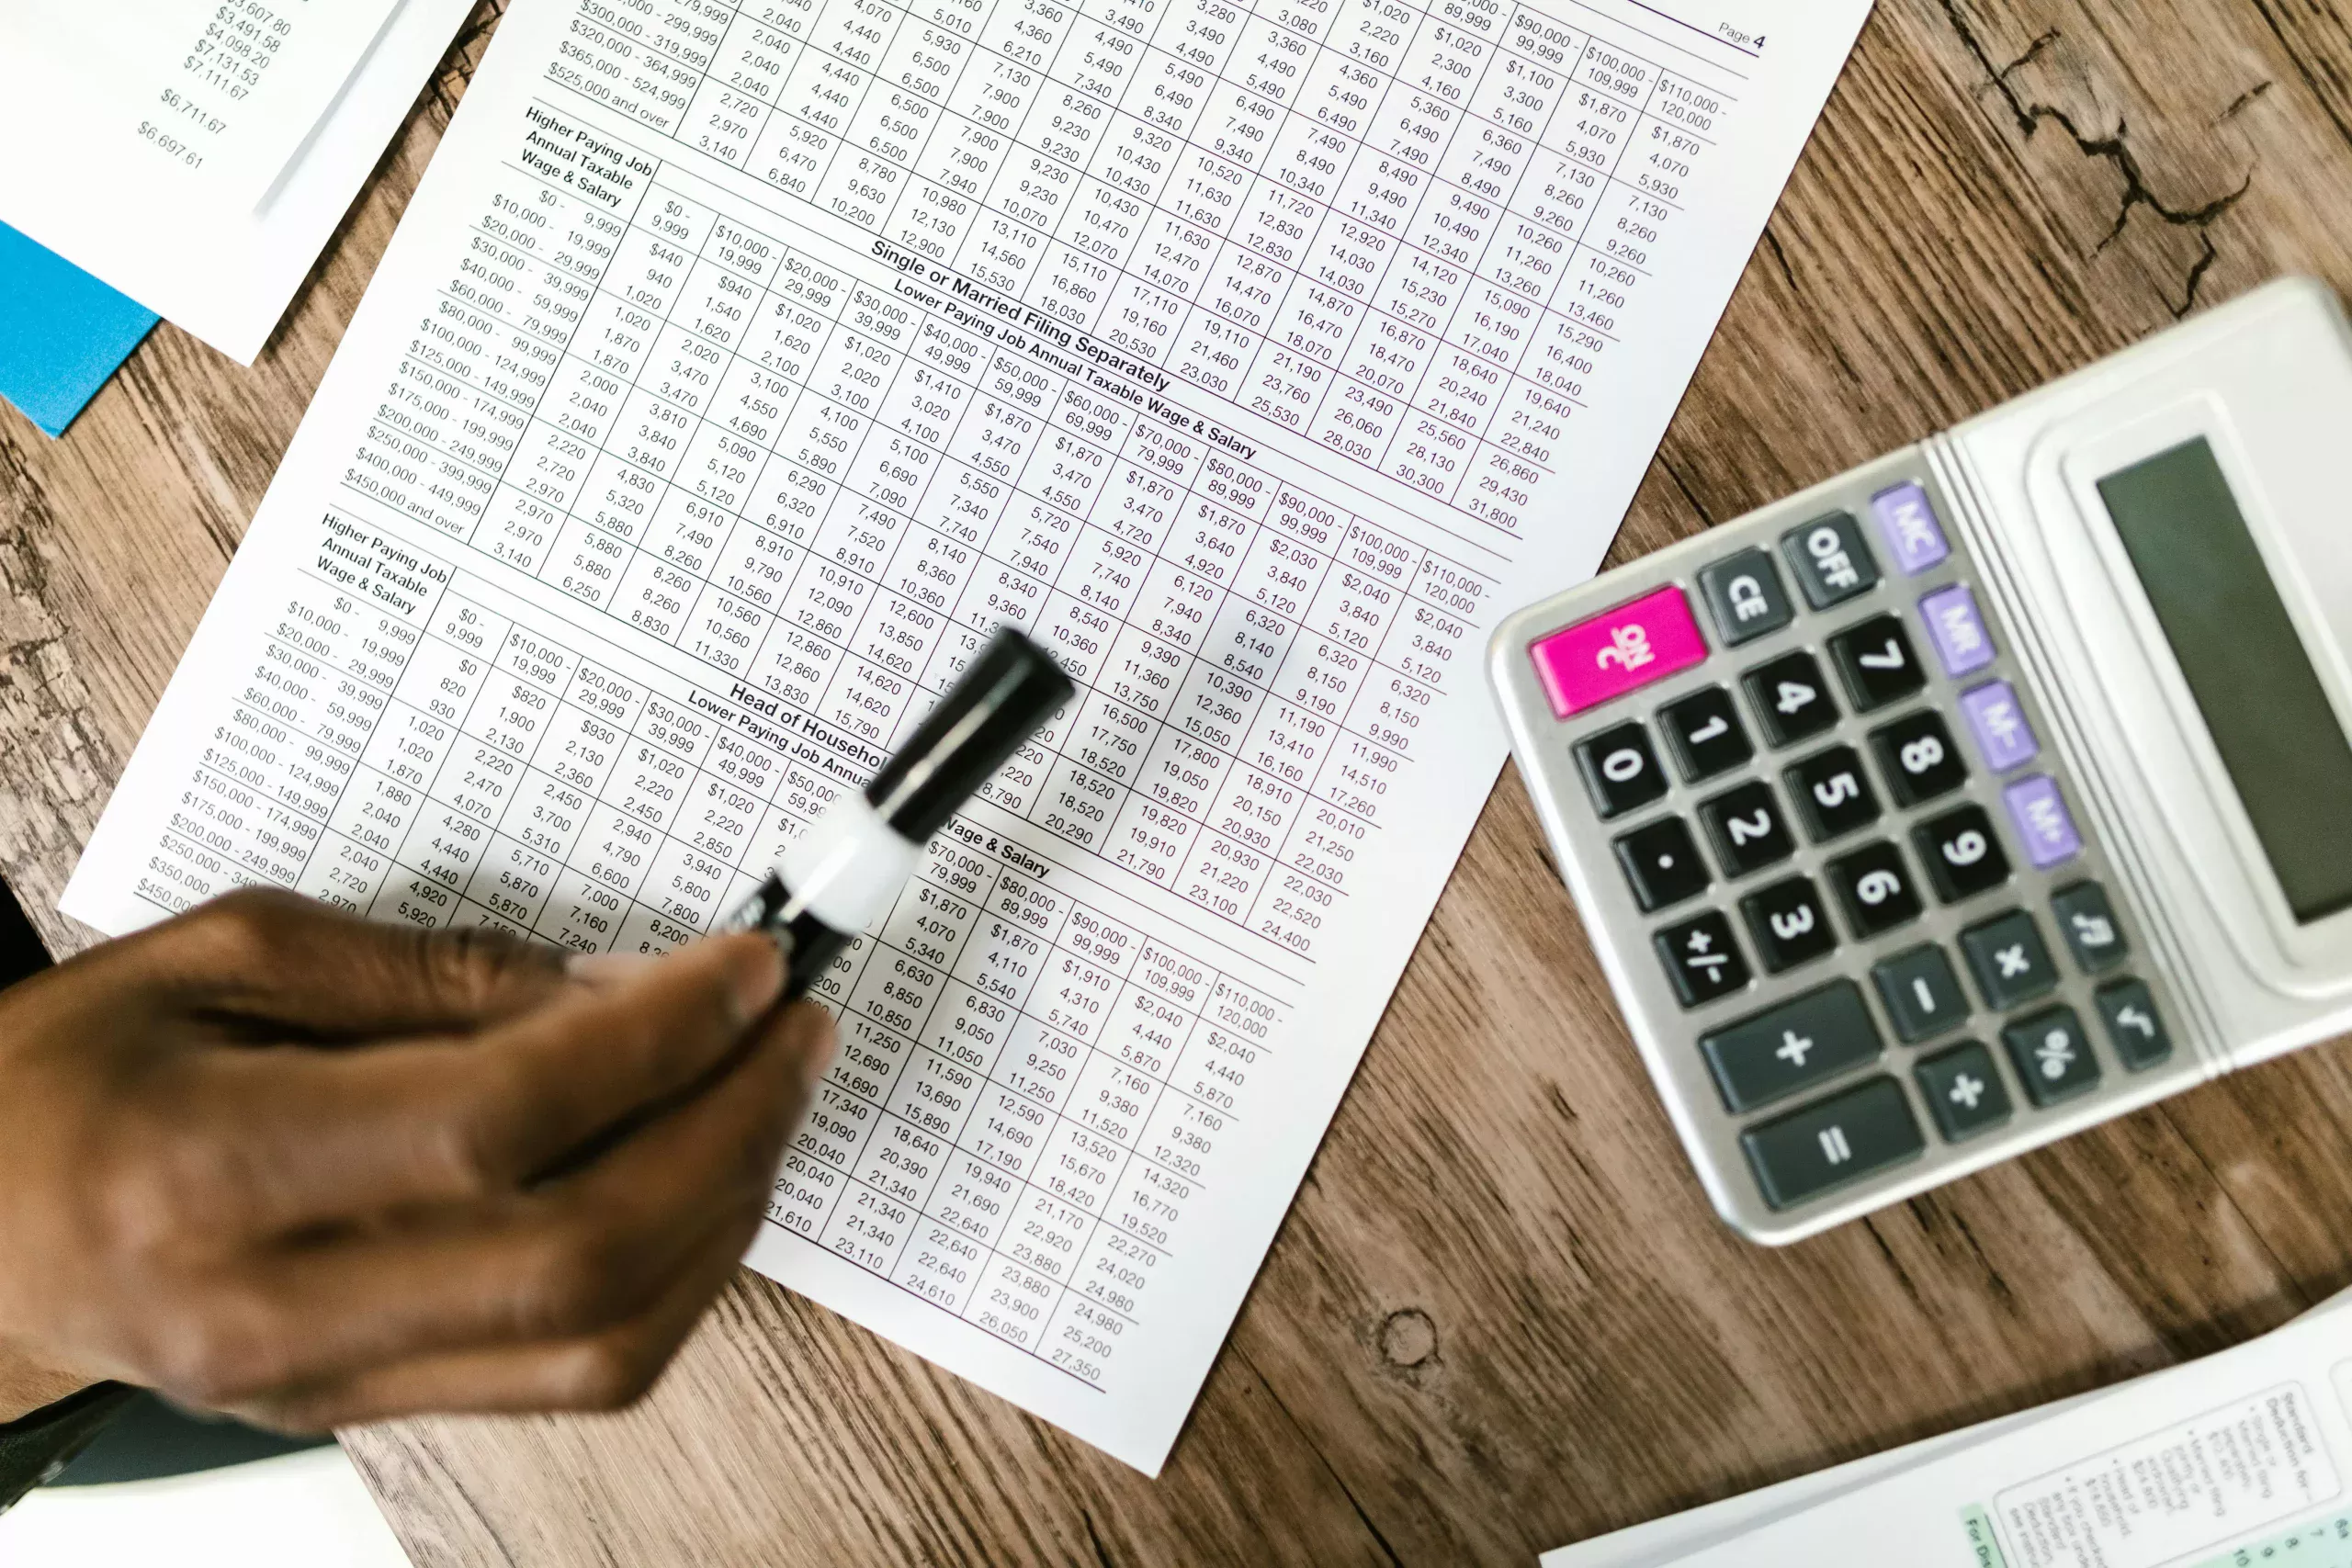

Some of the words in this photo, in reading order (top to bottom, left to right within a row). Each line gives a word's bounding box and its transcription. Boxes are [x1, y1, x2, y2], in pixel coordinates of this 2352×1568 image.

[216, 6, 281, 52] $3,491.58
[226, 0, 291, 36] 3,607.80
[1104, 8, 1145, 35] 3,490
[205, 22, 270, 69] $4,098.20
[752, 28, 791, 54] 2,040
[1434, 27, 1482, 57] $1,020
[1718, 21, 1750, 44] Page
[1752, 35, 1767, 50] 4
[194, 39, 259, 86] $7,131.53
[570, 19, 632, 58] $320,000
[642, 55, 697, 89] 364,999
[1003, 40, 1042, 66] 6,210
[184, 55, 249, 101] $7,111.67
[1589, 67, 1639, 98] 109,999
[161, 88, 227, 134] $6,711.67
[548, 62, 611, 100] $525,000
[611, 96, 639, 114] and
[639, 109, 670, 129] over
[1062, 94, 1102, 120] 8,260
[1578, 92, 1627, 123] $1,870
[1661, 100, 1712, 131] 120,000
[137, 120, 203, 169] $6,697.61
[525, 106, 575, 138] Higher
[574, 130, 624, 165] Paying
[625, 156, 652, 176] Job
[699, 135, 738, 161] 3,140
[525, 130, 578, 163] Annual
[580, 153, 633, 190] Taxable
[1197, 156, 1243, 186] 10,520
[1649, 152, 1690, 177] 4,070
[521, 148, 561, 177] Wage
[563, 170, 574, 185] &
[577, 176, 622, 209] Salary
[1638, 173, 1679, 199] 5,930
[651, 214, 689, 240] 9,999
[831, 197, 876, 226] 10,200
[1617, 217, 1657, 243] 8,260
[649, 243, 684, 267] $440
[718, 276, 752, 300] $940
[970, 262, 1015, 292] 15,530
[626, 285, 662, 310] 1,020
[1308, 288, 1354, 317] 14,870
[871, 240, 925, 276] Single
[929, 270, 951, 287] or
[951, 276, 1023, 321] Married
[1023, 310, 1072, 348] Filing
[1074, 336, 1171, 393] Separately
[1108, 328, 1157, 358] 20,530
[893, 277, 944, 310] Lower
[943, 301, 996, 338] Paying
[997, 328, 1026, 350] Job
[1027, 343, 1084, 377] Annual
[1085, 367, 1144, 406] Taxable
[1147, 396, 1191, 428] Wage
[1192, 420, 1204, 436] &
[1207, 426, 1258, 460] Salary
[984, 402, 1032, 434] $1,870
[1525, 389, 1571, 419] 19,640
[377, 403, 439, 442] $200,000
[448, 439, 503, 473] 249,999
[889, 438, 929, 465] 5,100
[1396, 464, 1444, 494] 30,300
[345, 468, 406, 506] $450,000
[407, 502, 435, 520] and
[435, 515, 465, 535] over
[1468, 498, 1518, 528] 31,800
[1892, 500, 1937, 553] MC
[322, 513, 370, 545] Higher
[370, 536, 419, 572] Paying
[420, 563, 447, 584] Job
[493, 542, 532, 568] 3,140
[1269, 538, 1318, 570] $2,030
[1807, 526, 1859, 588] OFF
[321, 536, 373, 570] Annual
[375, 560, 428, 597] Taxable
[317, 555, 356, 584] Wage
[357, 577, 369, 592] &
[371, 583, 417, 615] Salary
[1729, 576, 1768, 622] CE
[631, 609, 670, 636] 8,830
[797, 609, 842, 639] 12,860
[1414, 607, 1464, 639] $2,040
[1939, 604, 1981, 652] MR
[458, 659, 478, 676] $0
[1859, 640, 1905, 669] 7
[440, 677, 467, 698] 820
[511, 685, 547, 710] $820
[1777, 682, 1816, 714] 4
[243, 687, 298, 722] $60,000
[316, 723, 361, 753] 79,999
[729, 682, 780, 717] Head
[780, 711, 803, 728] of
[801, 718, 888, 772] Househol
[835, 709, 880, 739] 15,790
[1379, 701, 1419, 728] 8,150
[1690, 716, 1728, 743] 1
[687, 689, 737, 722] Lower
[737, 714, 790, 751] Paying
[790, 742, 820, 764] Job
[820, 757, 872, 789] Annua
[1174, 738, 1220, 769] 17,800
[1901, 736, 1944, 773] 8
[638, 748, 684, 780] $1,020
[718, 759, 764, 788] 49,999
[1351, 742, 1398, 773] 11,990
[1603, 749, 1644, 782] 0
[1814, 772, 1860, 807] 5
[1727, 808, 1771, 846] 2
[985, 837, 999, 854] &
[1000, 844, 1051, 879] Salary
[1942, 829, 1987, 865] 9
[1116, 848, 1166, 880] 21,790
[1857, 869, 1900, 905] 6
[488, 892, 528, 920] 5,870
[662, 897, 700, 925] 7,800
[1261, 919, 1311, 952] 24,400
[1770, 905, 1815, 940] 3
[894, 959, 934, 987] 6,630
[1062, 959, 1111, 992] $1,910
[866, 999, 912, 1032] 10,850
[844, 1043, 890, 1077] 12,690
[821, 1089, 868, 1121] 17,340
[1099, 1089, 1139, 1117] 9,380
[879, 1146, 929, 1179] 20,390
[1122, 1213, 1168, 1245] 19,520
[834, 1236, 884, 1269] 23,110
[906, 1273, 956, 1306] 24,610
[1051, 1348, 1101, 1381] 27,350
